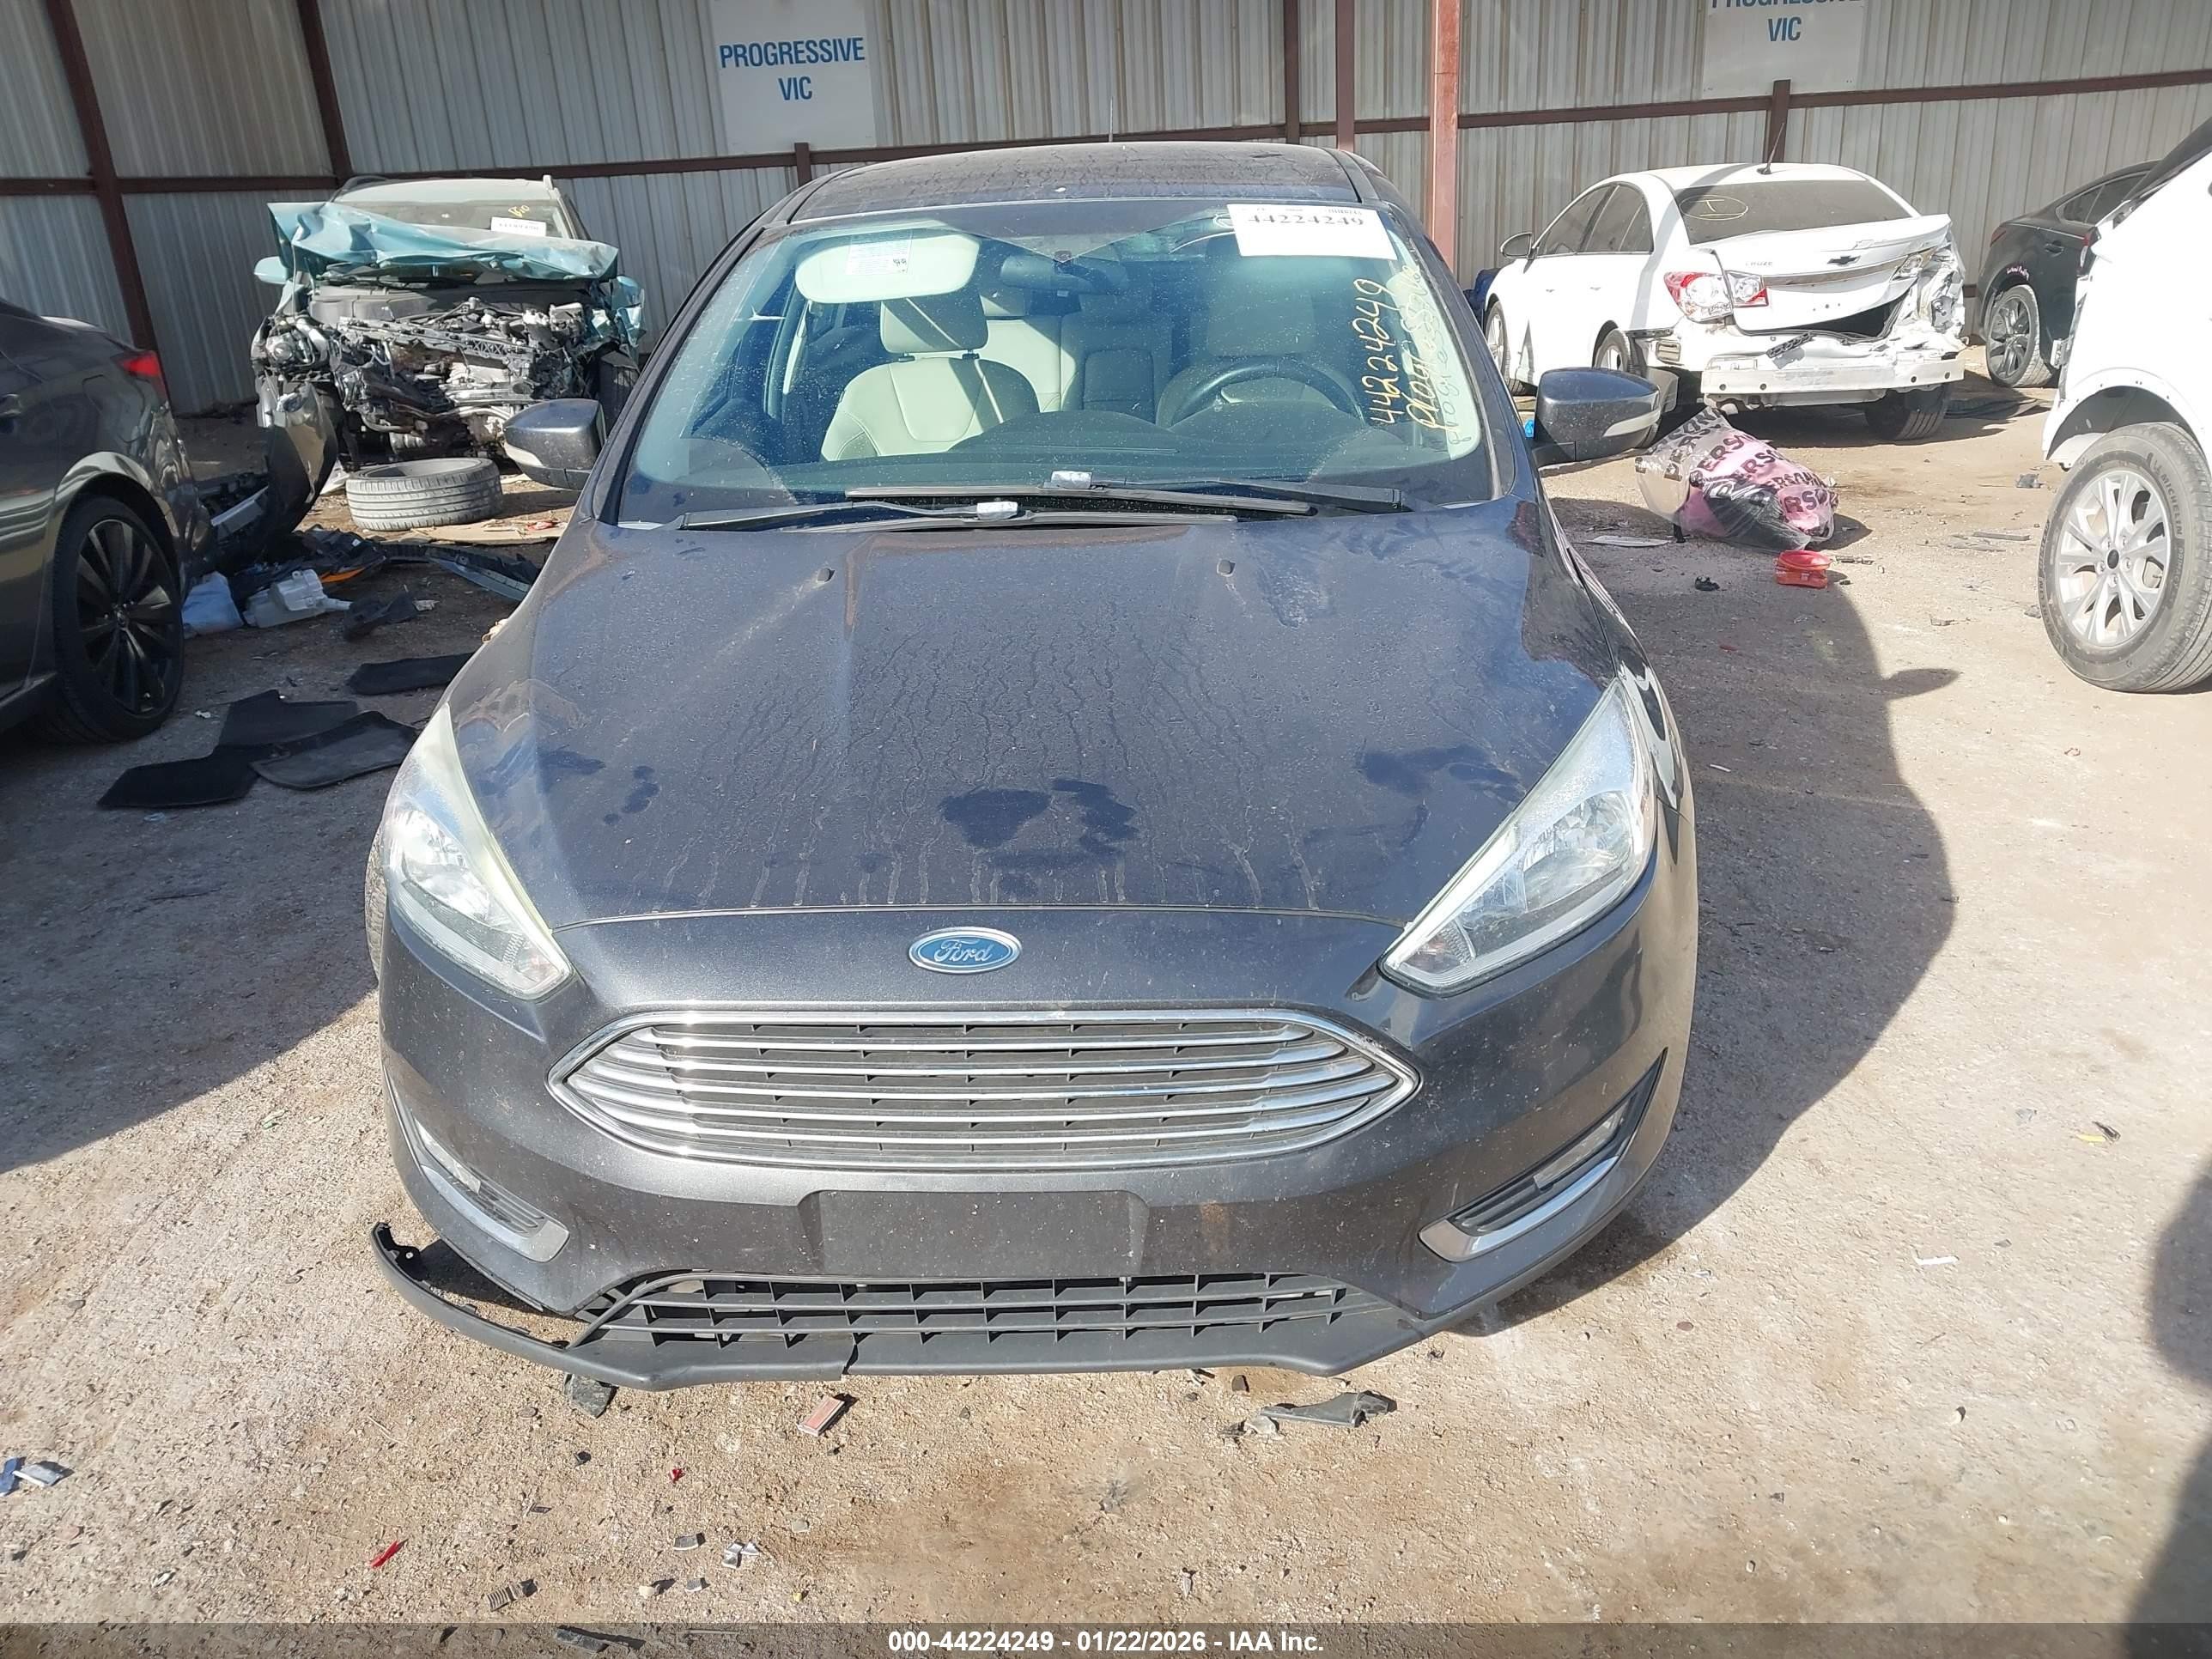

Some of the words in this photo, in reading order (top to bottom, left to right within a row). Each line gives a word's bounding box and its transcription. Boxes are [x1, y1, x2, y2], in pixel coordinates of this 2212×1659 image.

[1767, 16, 1802, 42] VIC
[719, 37, 866, 69] PROGRESSIVE
[778, 76, 813, 100] VIC
[1248, 214, 1364, 226] 44224249
[1351, 277, 1405, 425] 44224249
[2160, 474, 2184, 535] MICHELIN
[933, 939, 994, 963] Ford
